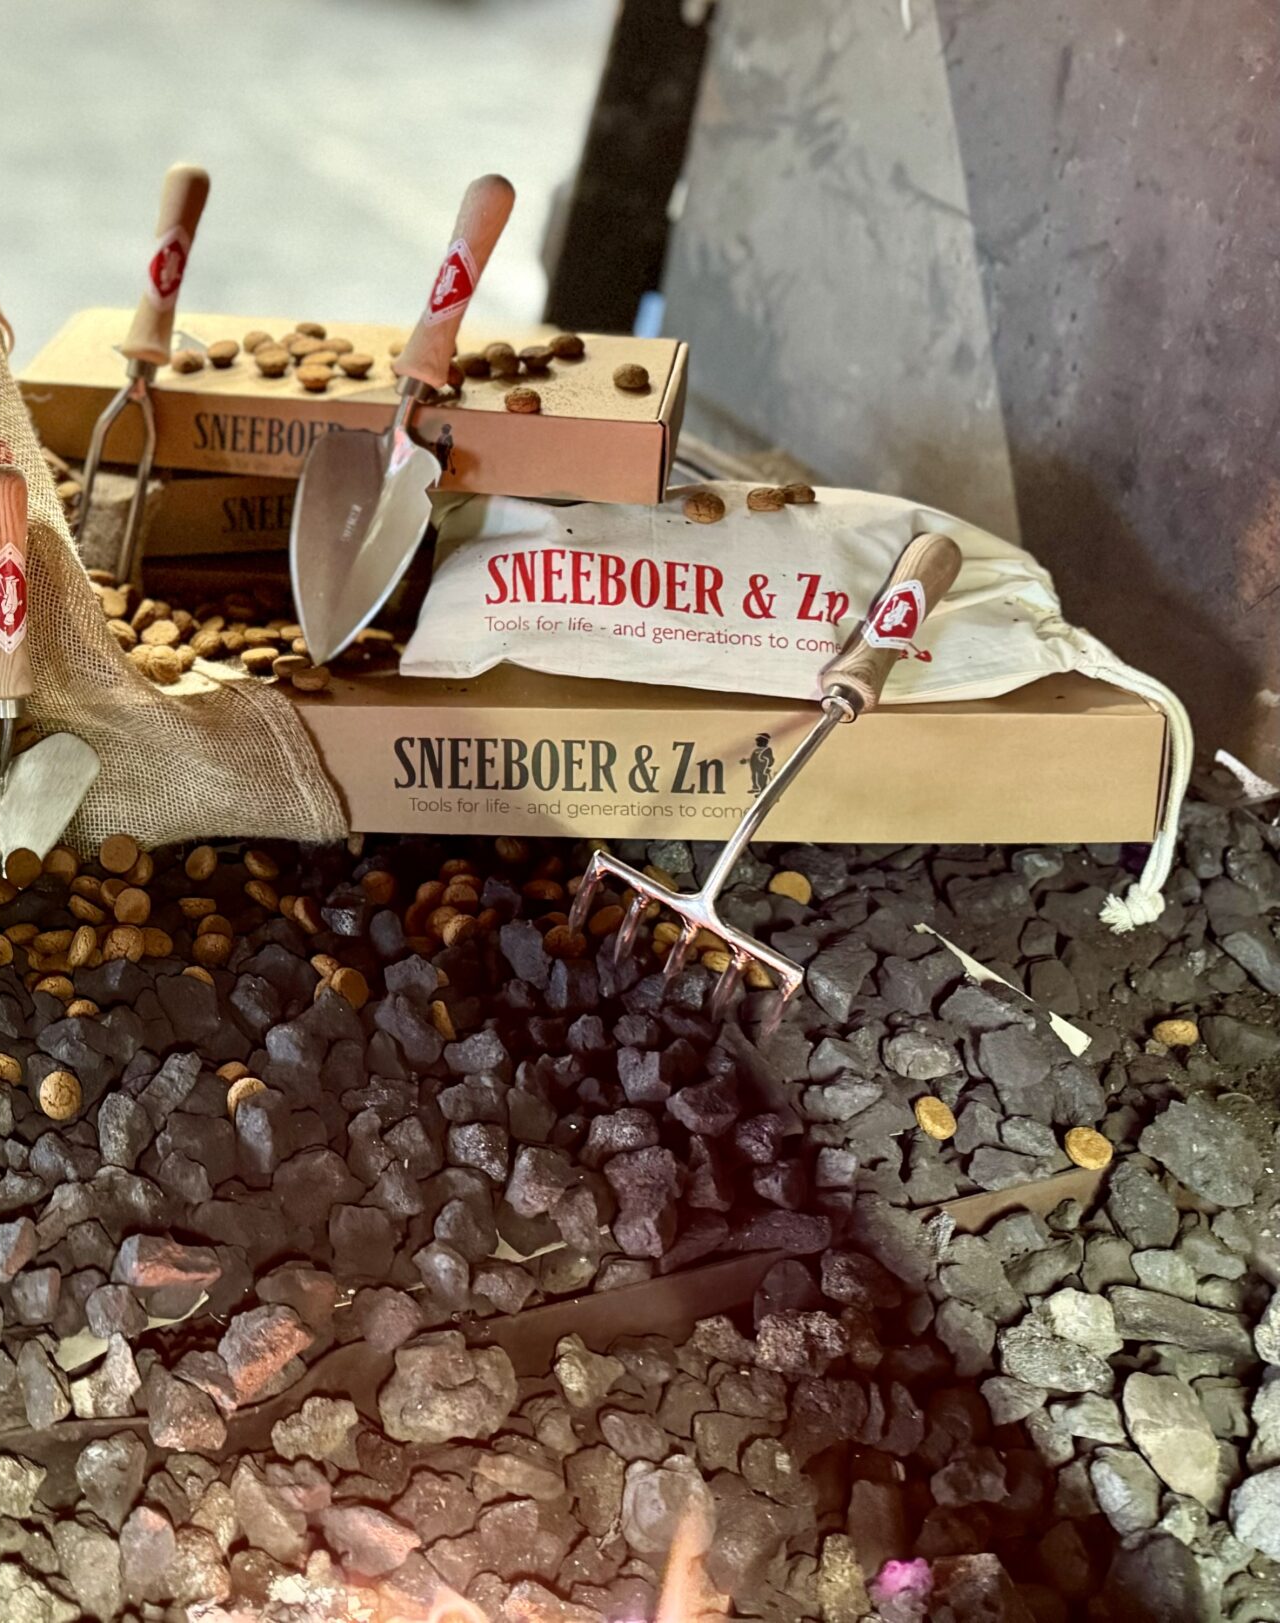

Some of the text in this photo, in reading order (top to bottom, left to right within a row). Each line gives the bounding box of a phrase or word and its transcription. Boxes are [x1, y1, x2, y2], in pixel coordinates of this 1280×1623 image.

[485, 549, 849, 627] SNEEBOER & Zn
[484, 616, 530, 632] Tools
[536, 616, 562, 632] for
[568, 617, 593, 632] life
[613, 622, 646, 638] and
[652, 625, 762, 647] generations
[769, 633, 789, 649] to
[394, 737, 726, 794] SNEEBOER & Zn
[409, 797, 452, 813] Tools
[457, 798, 480, 813] for
[486, 799, 510, 813] life
[527, 800, 561, 815] and
[567, 802, 673, 818] generations
[679, 805, 697, 818] to
